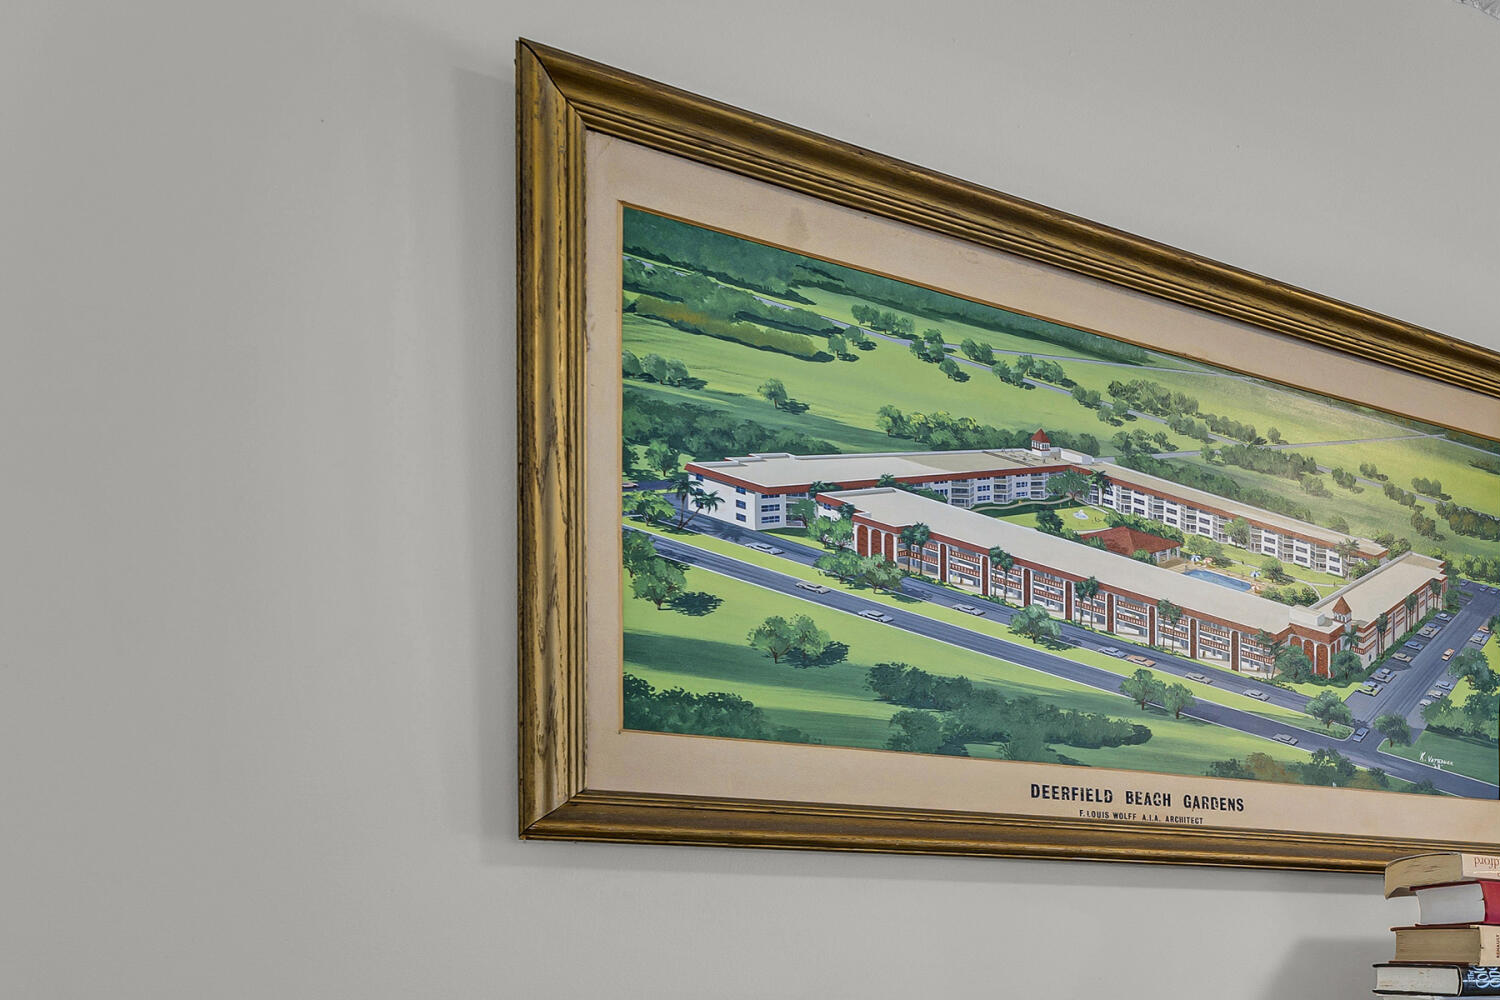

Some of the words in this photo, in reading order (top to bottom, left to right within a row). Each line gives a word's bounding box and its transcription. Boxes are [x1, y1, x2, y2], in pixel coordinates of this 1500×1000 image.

[1031, 783, 1113, 804] DEERFIELD
[1125, 790, 1171, 807] BEACH
[1183, 794, 1244, 812] GARDENS
[1087, 810, 1109, 819] LOUIS
[1113, 812, 1137, 821] WOLFF
[1165, 815, 1203, 825] ARCHITECT
